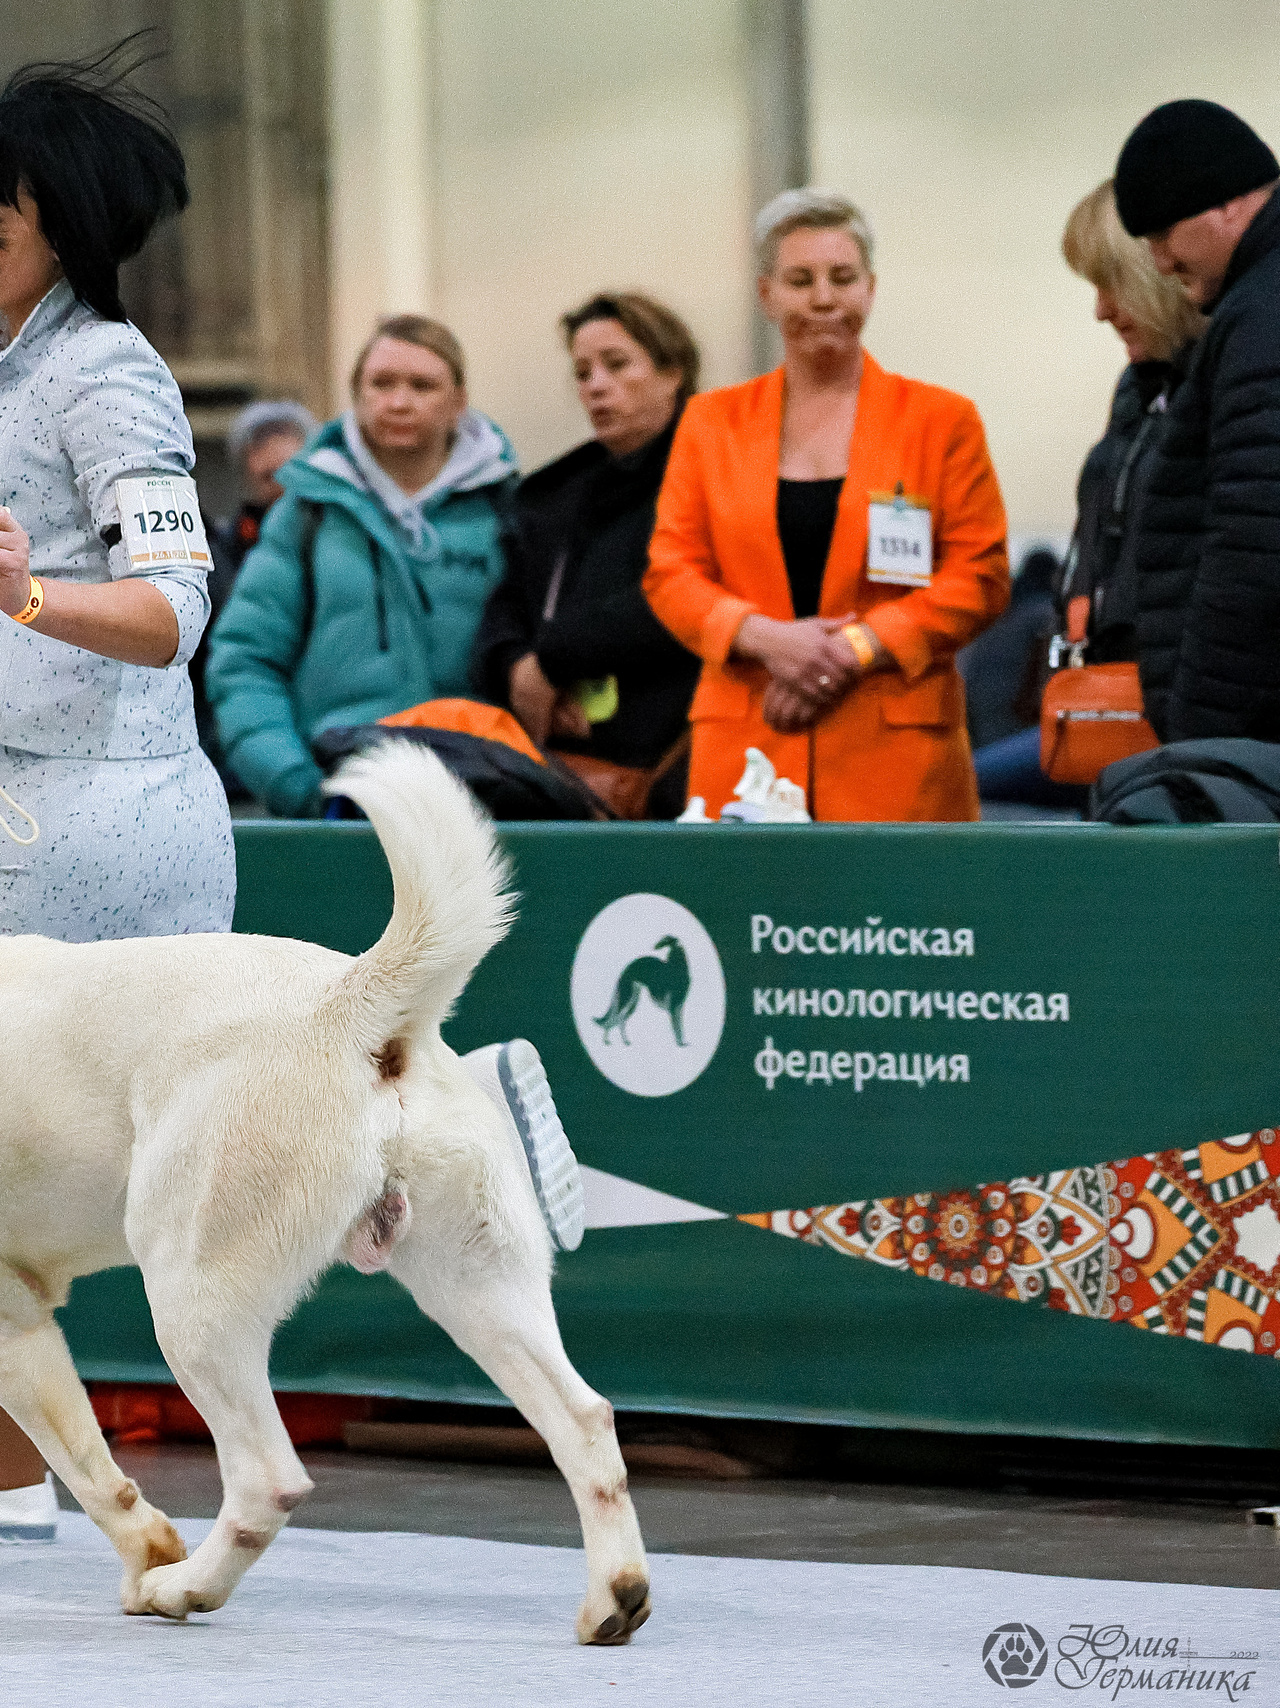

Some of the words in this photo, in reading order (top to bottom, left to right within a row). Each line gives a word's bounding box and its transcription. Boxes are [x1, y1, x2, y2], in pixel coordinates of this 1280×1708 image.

[134, 509, 194, 534] 1290
[750, 914, 975, 957] Российская
[752, 987, 1071, 1022] кинологическая
[753, 1036, 971, 1092] федерация
